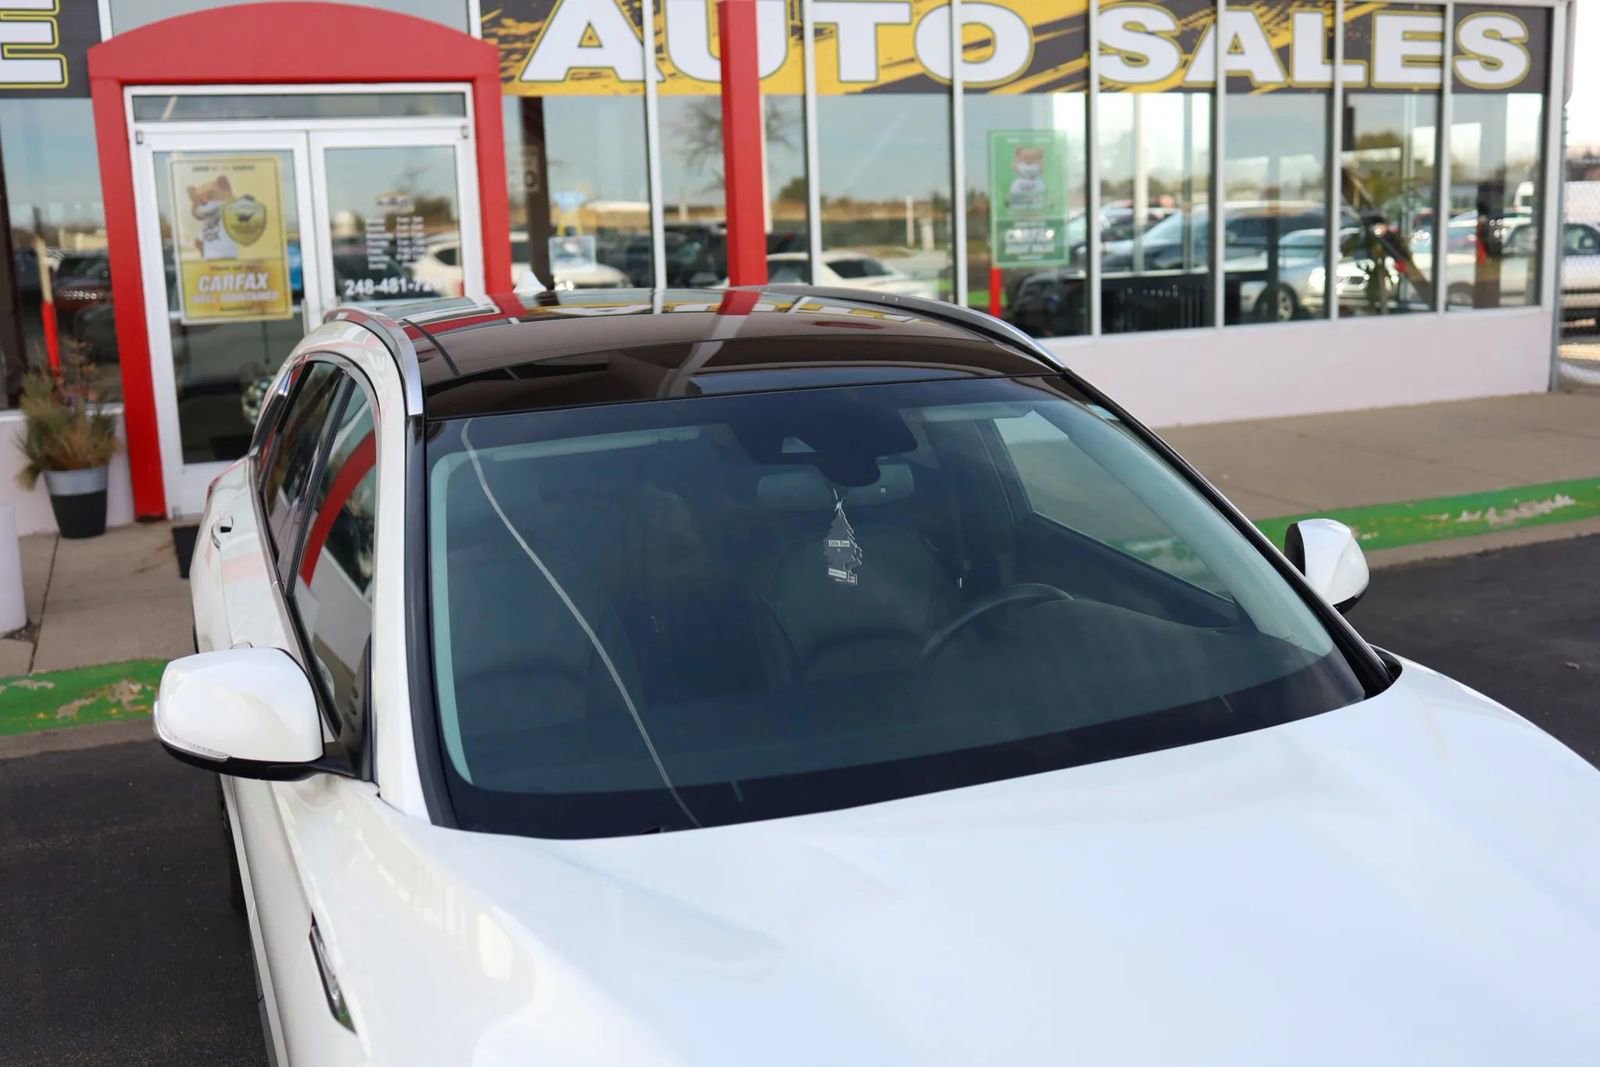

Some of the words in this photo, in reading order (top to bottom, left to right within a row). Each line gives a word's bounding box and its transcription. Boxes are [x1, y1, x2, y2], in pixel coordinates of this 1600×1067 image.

[520, 0, 1034, 86] AUTO
[1096, 5, 1531, 88] SALES
[198, 271, 270, 292] CARFAX
[343, 276, 450, 296] 248-481-72
